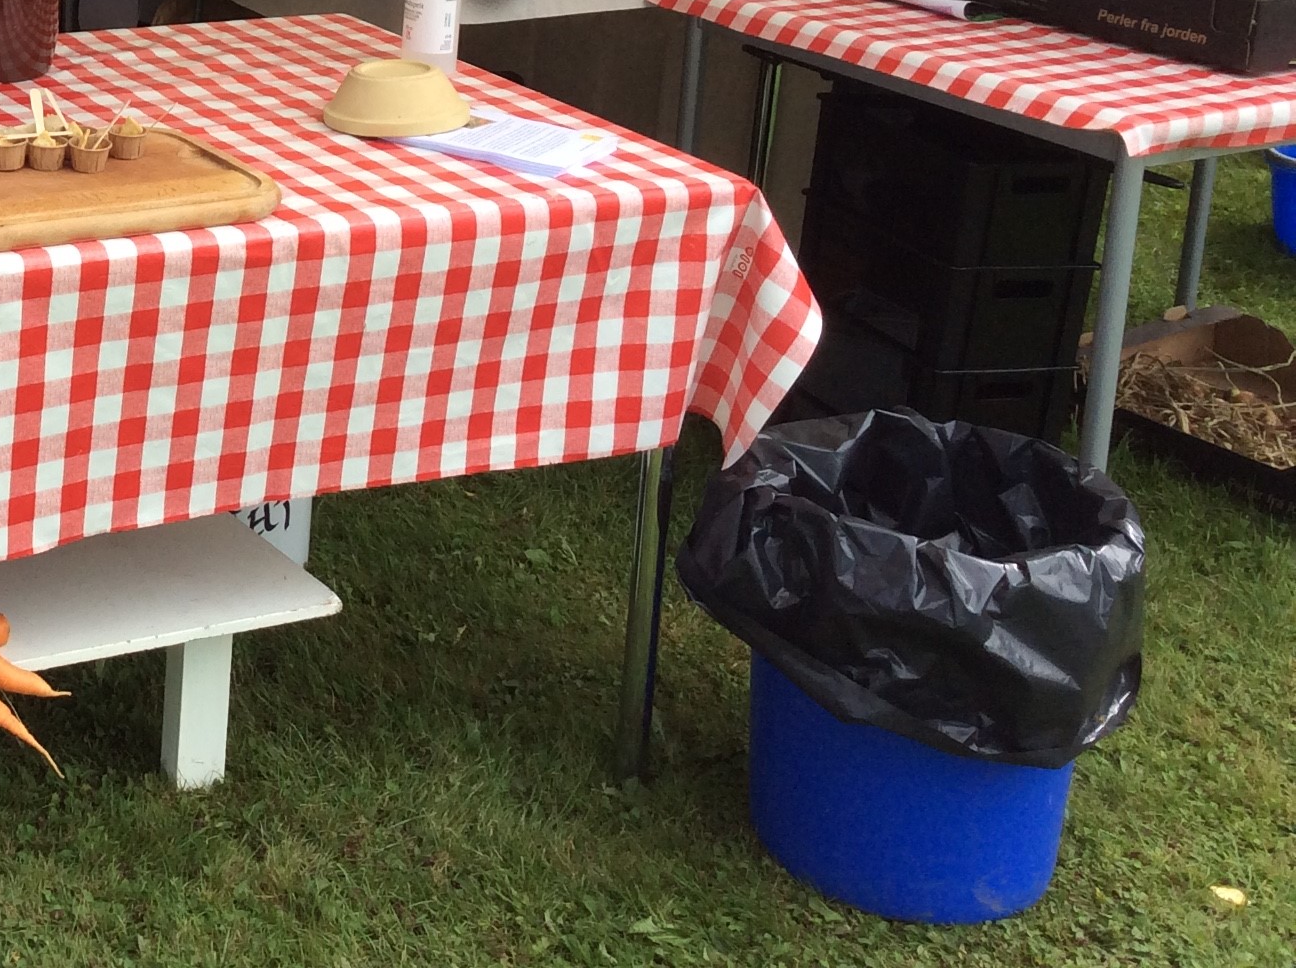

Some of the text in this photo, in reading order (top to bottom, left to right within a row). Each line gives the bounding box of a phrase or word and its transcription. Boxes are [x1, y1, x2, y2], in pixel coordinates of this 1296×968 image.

[1097, 8, 1208, 46] Perler fra jorden
